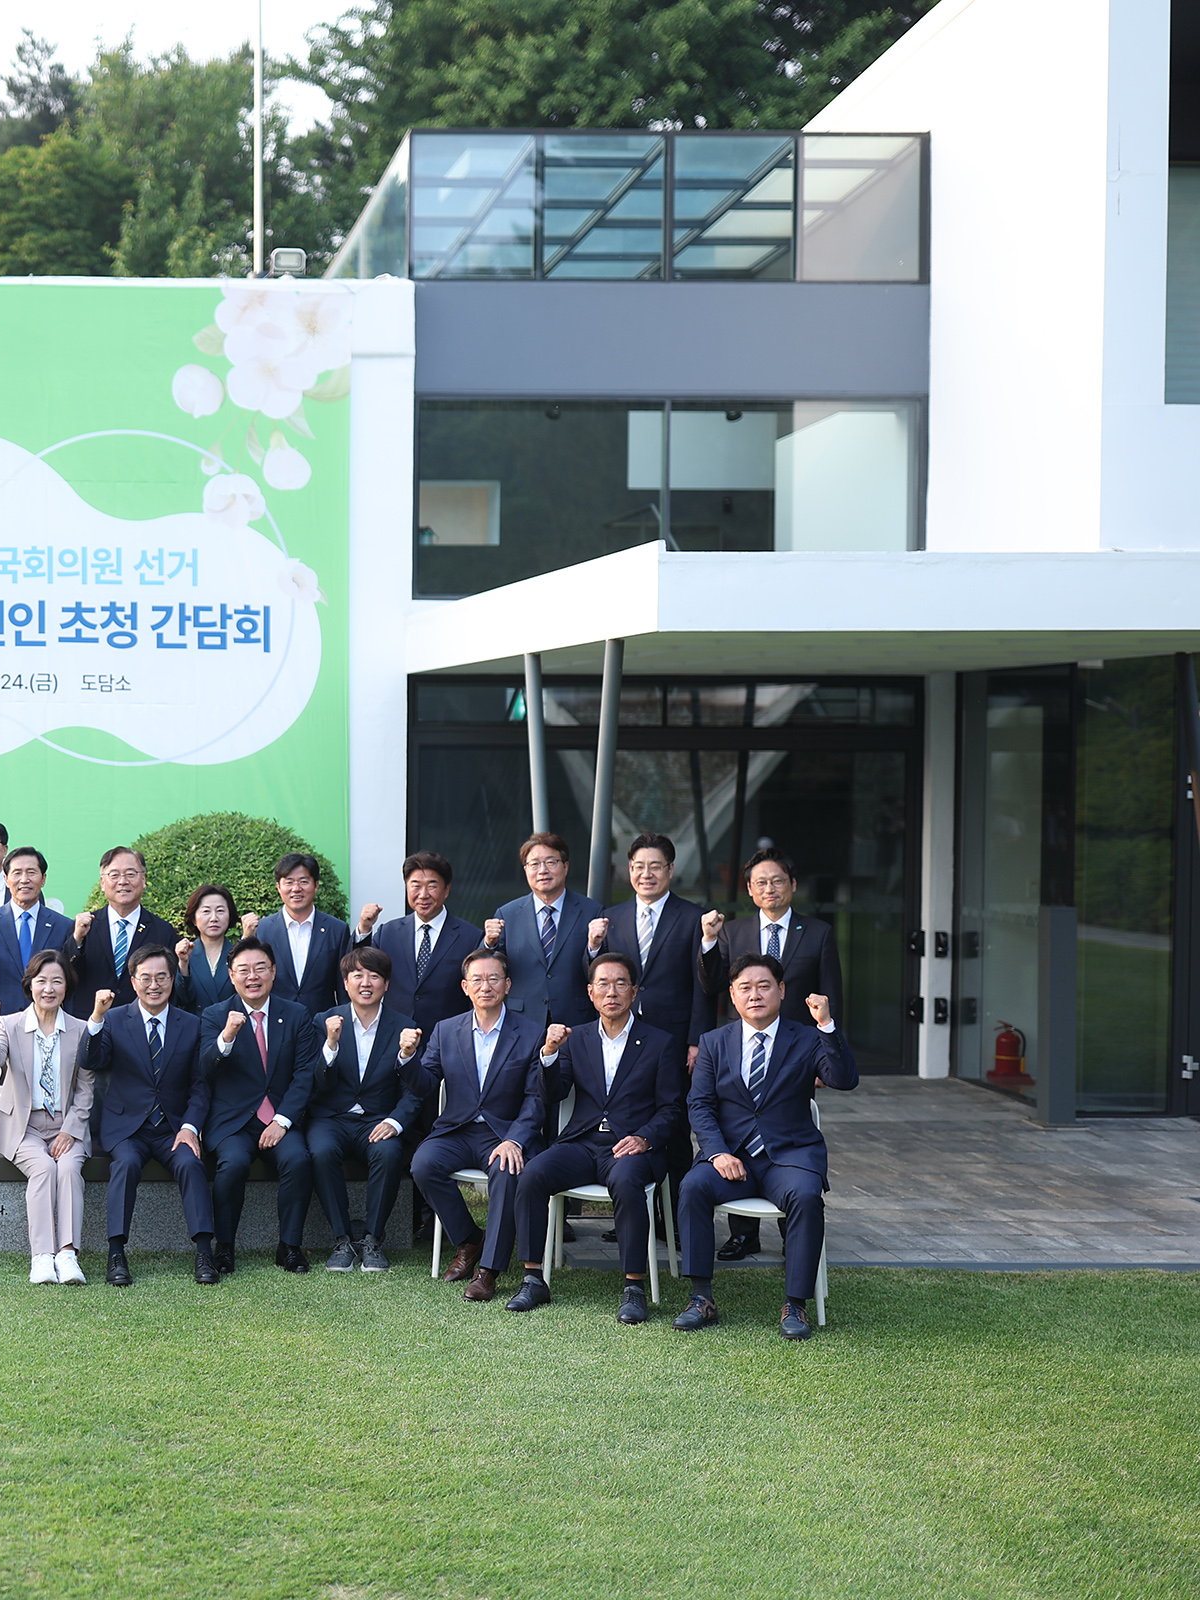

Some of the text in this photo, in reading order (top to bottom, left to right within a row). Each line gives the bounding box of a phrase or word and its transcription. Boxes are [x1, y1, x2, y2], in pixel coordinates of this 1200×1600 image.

[132, 547, 200, 587] 선거
[57, 600, 139, 650] 초청
[149, 602, 272, 654] 간담회
[81, 673, 132, 693] 도담소
